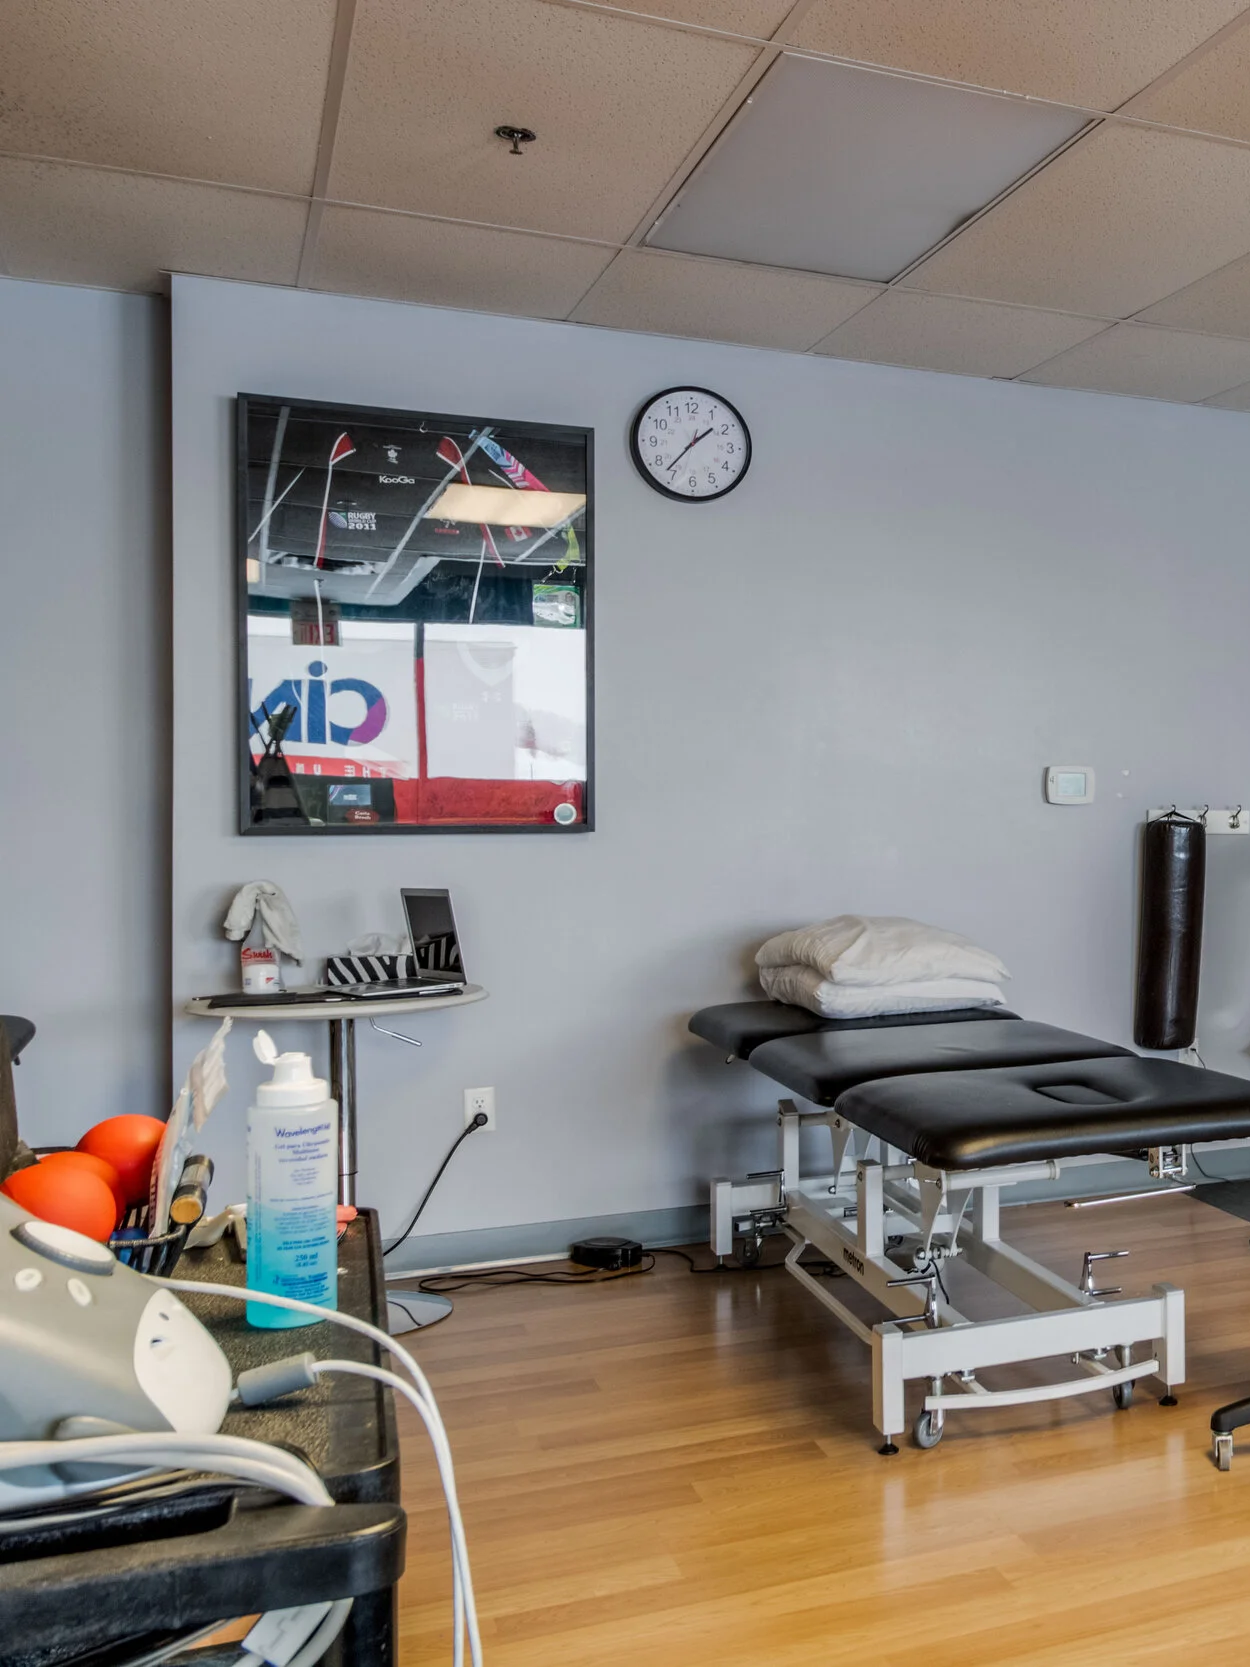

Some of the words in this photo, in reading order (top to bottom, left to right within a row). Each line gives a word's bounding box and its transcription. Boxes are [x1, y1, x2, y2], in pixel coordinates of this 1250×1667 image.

[666, 405, 680, 417] 11
[685, 402, 699, 414] 12
[708, 409, 715, 420] 1
[653, 418, 668, 431] 10
[720, 423, 729, 435] 2
[649, 435, 658, 447] 9
[726, 442, 735, 454] 3
[655, 454, 663, 466] 8
[721, 460, 730, 472] 4
[378, 475, 415, 485] KooGa
[668, 469, 677, 480] 7
[708, 472, 717, 484] 5
[688, 475, 697, 487] 6
[347, 511, 377, 520] RUGBY
[843, 1247, 865, 1277] metron
